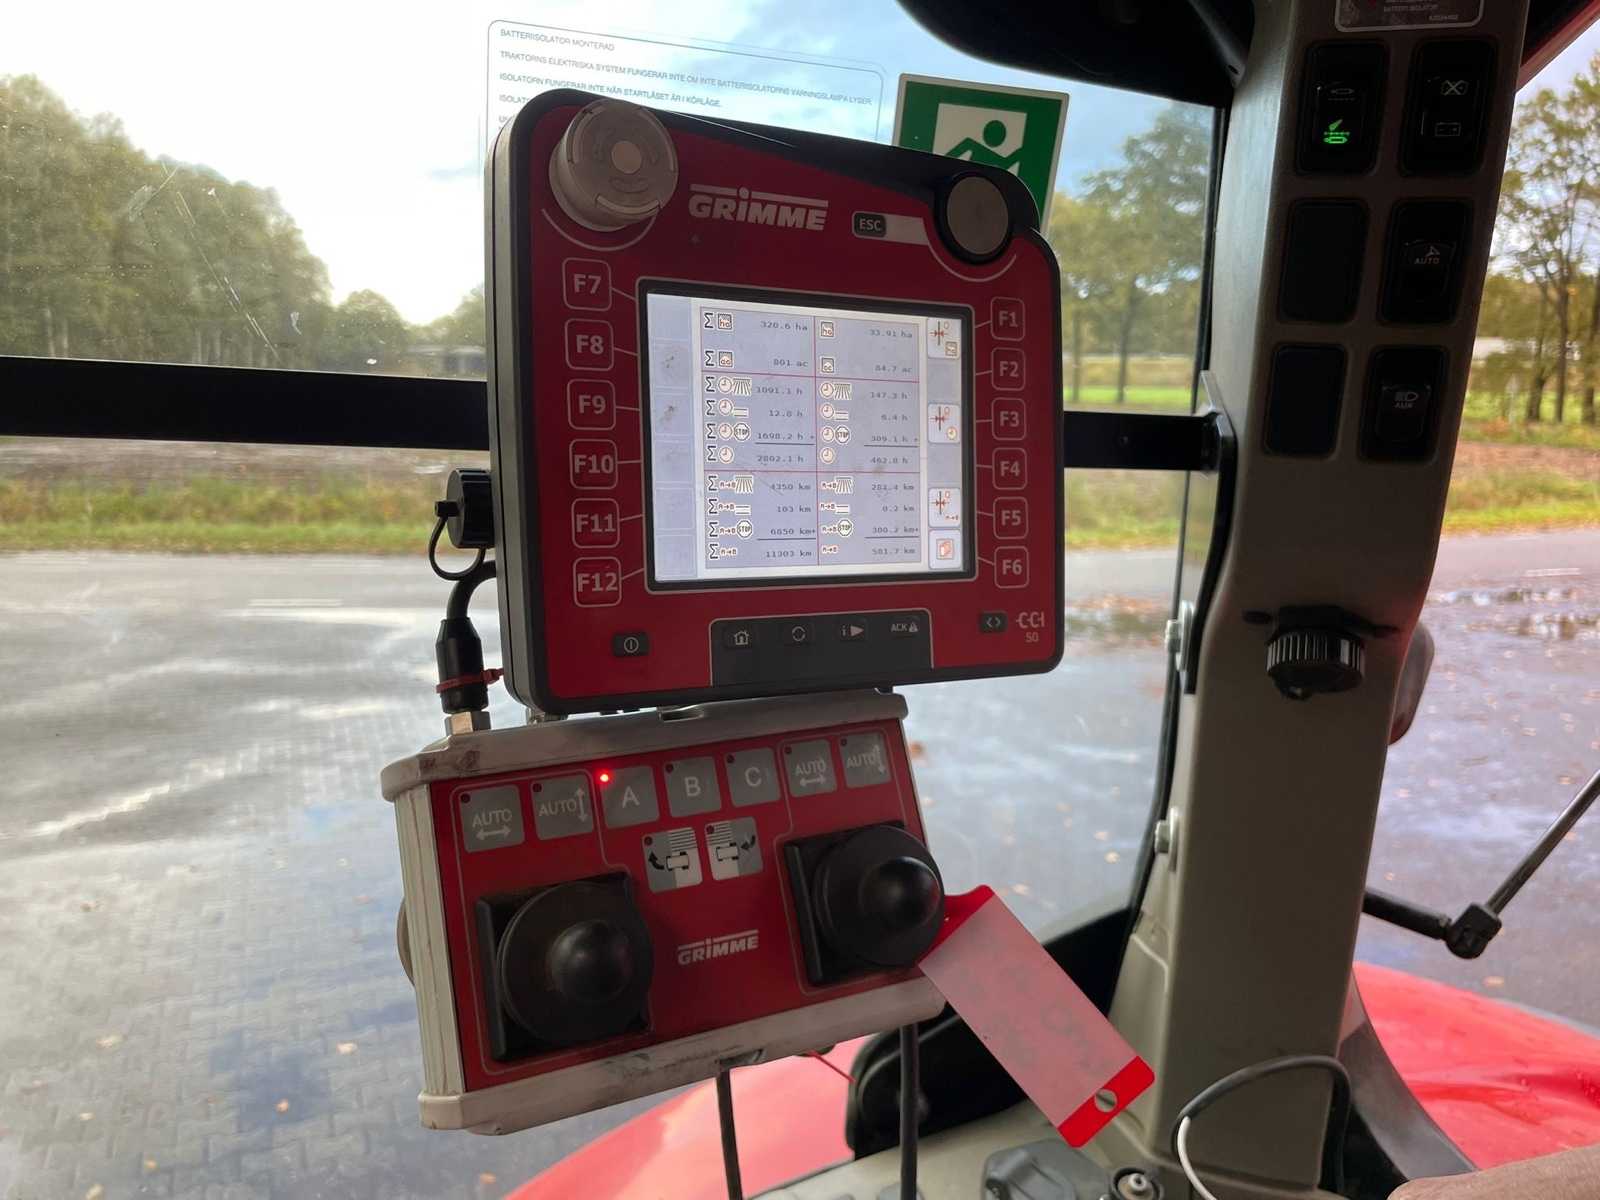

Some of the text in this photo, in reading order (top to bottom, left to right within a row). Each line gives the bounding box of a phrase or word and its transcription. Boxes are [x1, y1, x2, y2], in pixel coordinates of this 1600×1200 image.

[572, 39, 615, 51] MONTERAD
[549, 56, 594, 70] ELEKTRISKA
[596, 63, 626, 74] SYSTEM
[627, 67, 667, 80] FUNGERAR
[860, 219, 882, 232] ESC
[1414, 257, 1440, 265] AUTO
[574, 274, 600, 294] F7
[795, 323, 808, 331] ha
[1000, 311, 1018, 327] F1
[576, 334, 603, 354] F8
[1000, 361, 1019, 377] F2
[579, 395, 606, 414] F9
[1000, 411, 1019, 427] F3
[574, 454, 613, 474] F10
[1000, 461, 1020, 477] F4
[799, 505, 812, 513] km
[1001, 510, 1021, 526] F5
[576, 513, 616, 533] F11
[800, 550, 812, 558] km
[1002, 559, 1022, 575] F6
[577, 572, 618, 592] F12
[890, 623, 908, 633] ACK
[794, 759, 827, 777] AUTO
[846, 753, 877, 771] AUTO
[744, 766, 762, 787] C
[684, 776, 701, 798] B
[621, 786, 640, 809] A
[538, 798, 577, 819] AUTO
[471, 808, 513, 829] AUTO
